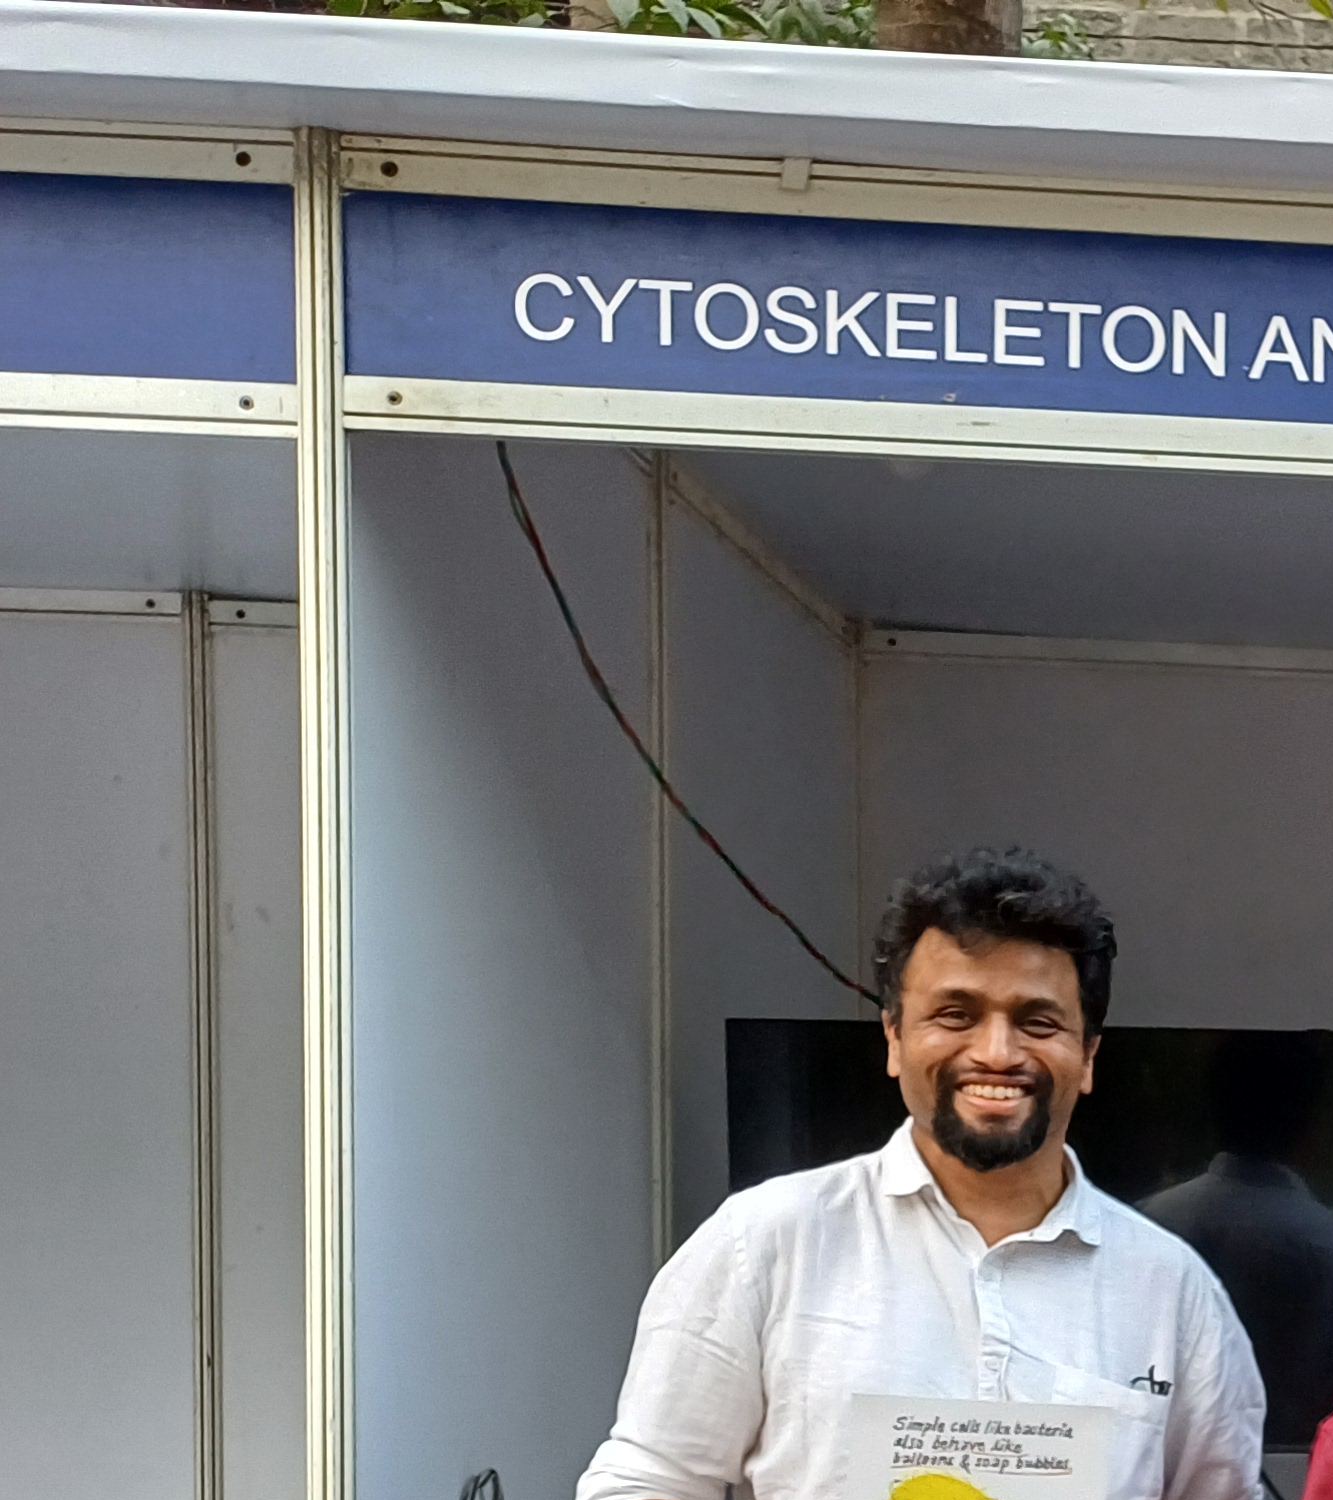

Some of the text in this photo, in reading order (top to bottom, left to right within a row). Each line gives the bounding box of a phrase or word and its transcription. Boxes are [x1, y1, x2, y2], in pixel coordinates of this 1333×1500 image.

[514, 273, 1226, 378] CYTOSKELETON
[893, 1416, 1074, 1438] Simple cells like bacteria
[893, 1435, 1023, 1452] also behave like
[893, 1452, 954, 1466] balloons
[959, 1454, 971, 1474] &
[975, 1456, 1010, 1473] soap
